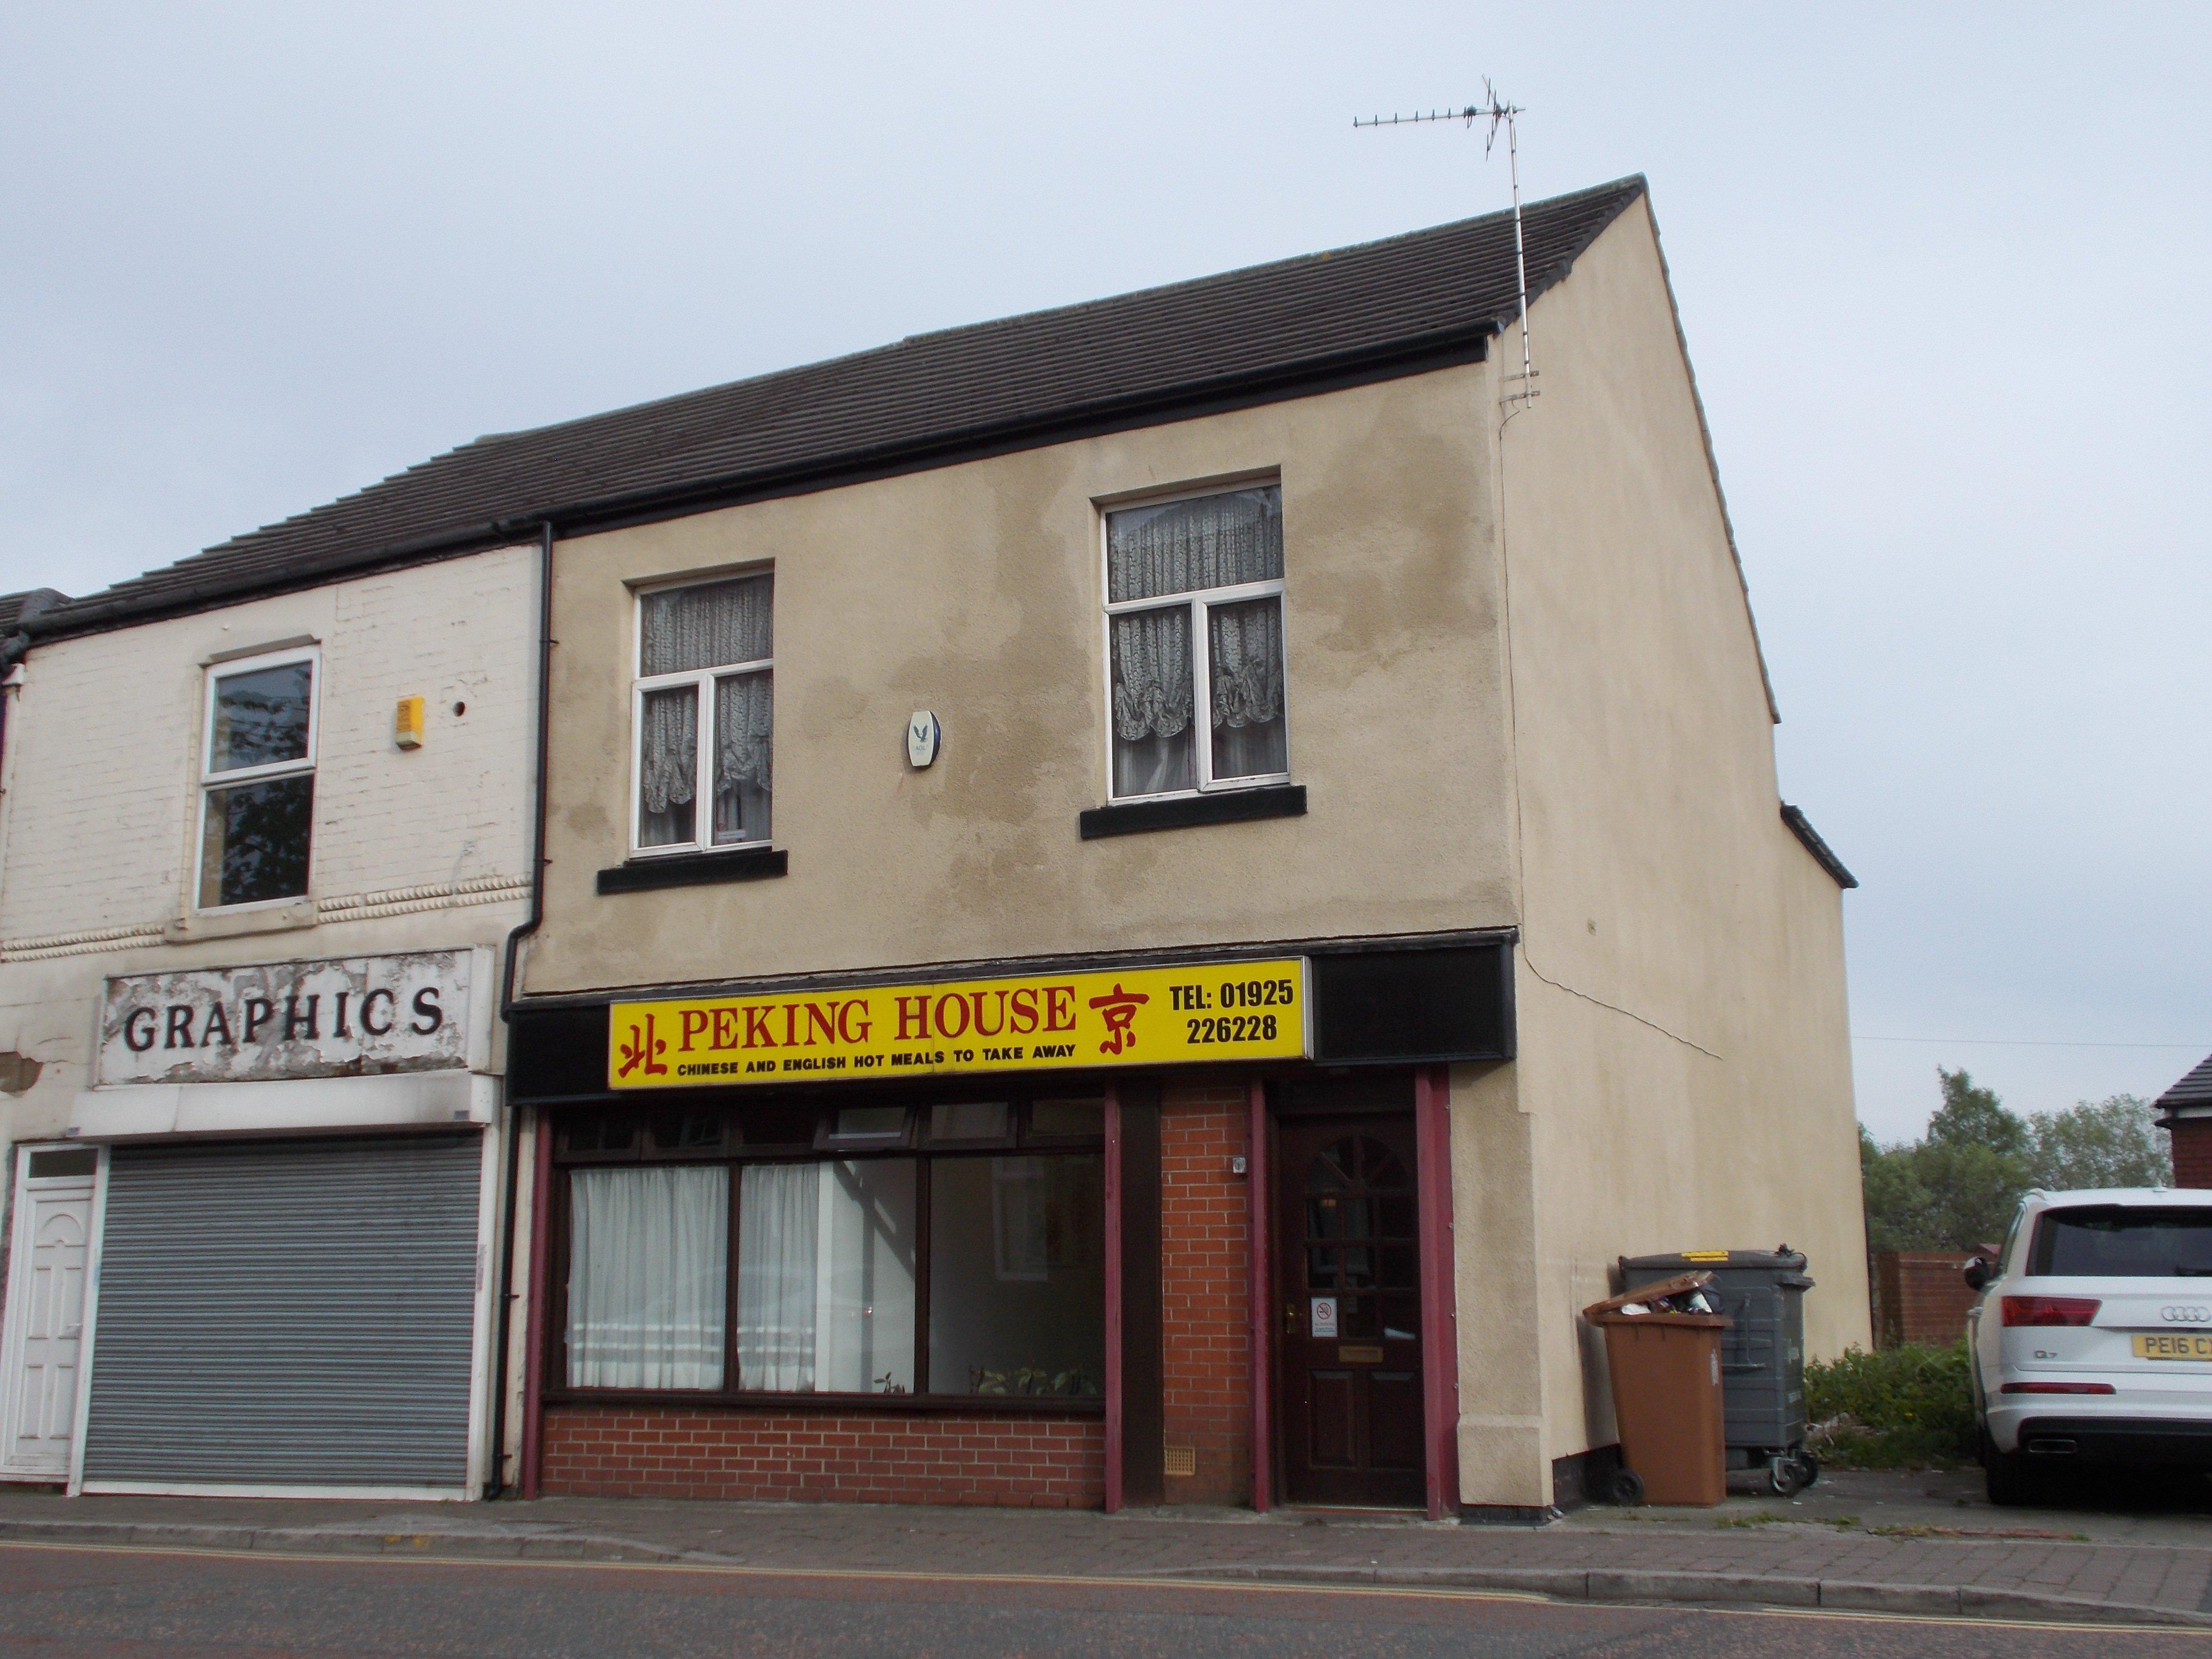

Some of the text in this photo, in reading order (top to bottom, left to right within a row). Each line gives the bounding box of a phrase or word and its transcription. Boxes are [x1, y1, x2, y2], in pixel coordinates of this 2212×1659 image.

[123, 986, 444, 1052] GRAPHICS
[677, 986, 1077, 1052] PEKING HOUSE
[1088, 983, 1151, 1056] 京
[1168, 979, 1294, 1011] TEL: 01925
[618, 1013, 668, 1079] 北
[1187, 1014, 1277, 1044] 226228
[677, 1044, 1076, 1076] CHINESE AND ENGLISH HOT MEALS TO TAKE AWAY
[2145, 1336, 2189, 1354] PE16
